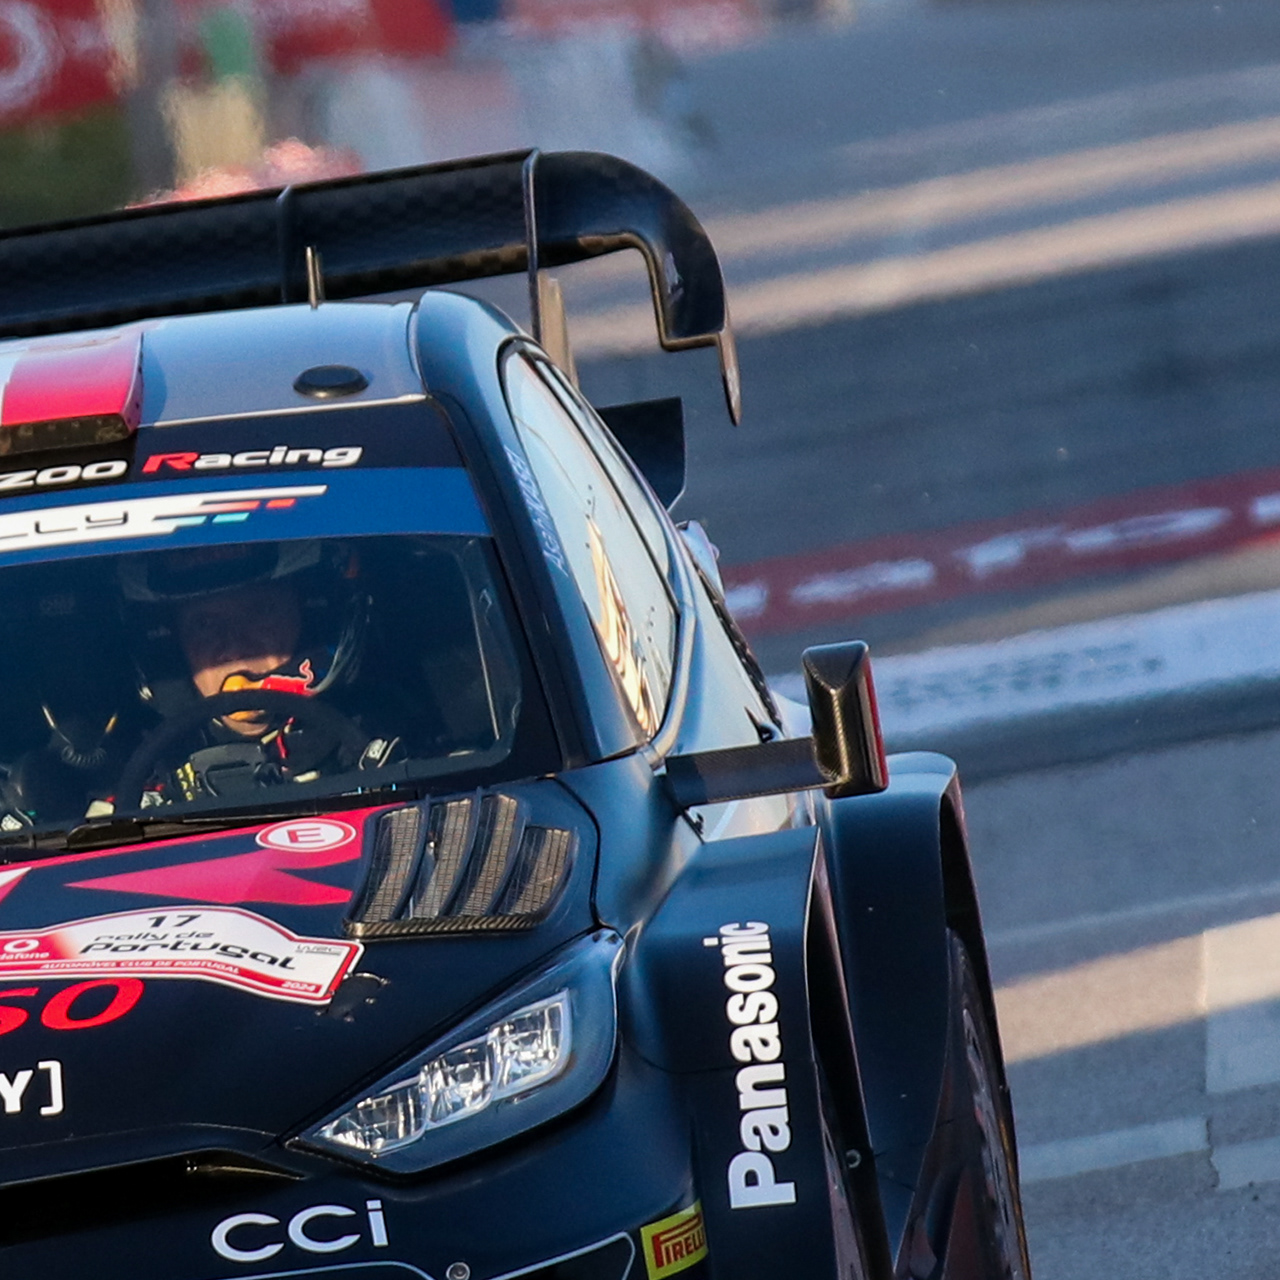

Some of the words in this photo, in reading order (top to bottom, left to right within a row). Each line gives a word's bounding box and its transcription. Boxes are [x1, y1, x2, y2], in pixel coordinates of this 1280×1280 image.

[141, 444, 363, 474] Racing
[147, 914, 201, 928] 17
[94, 932, 169, 941] rally
[175, 930, 215, 939] de
[173, 960, 239, 975] PORTUGAL
[281, 980, 317, 992] 2024
[703, 921, 797, 1209] Panasonic
[651, 1212, 705, 1269] PIRELLI
